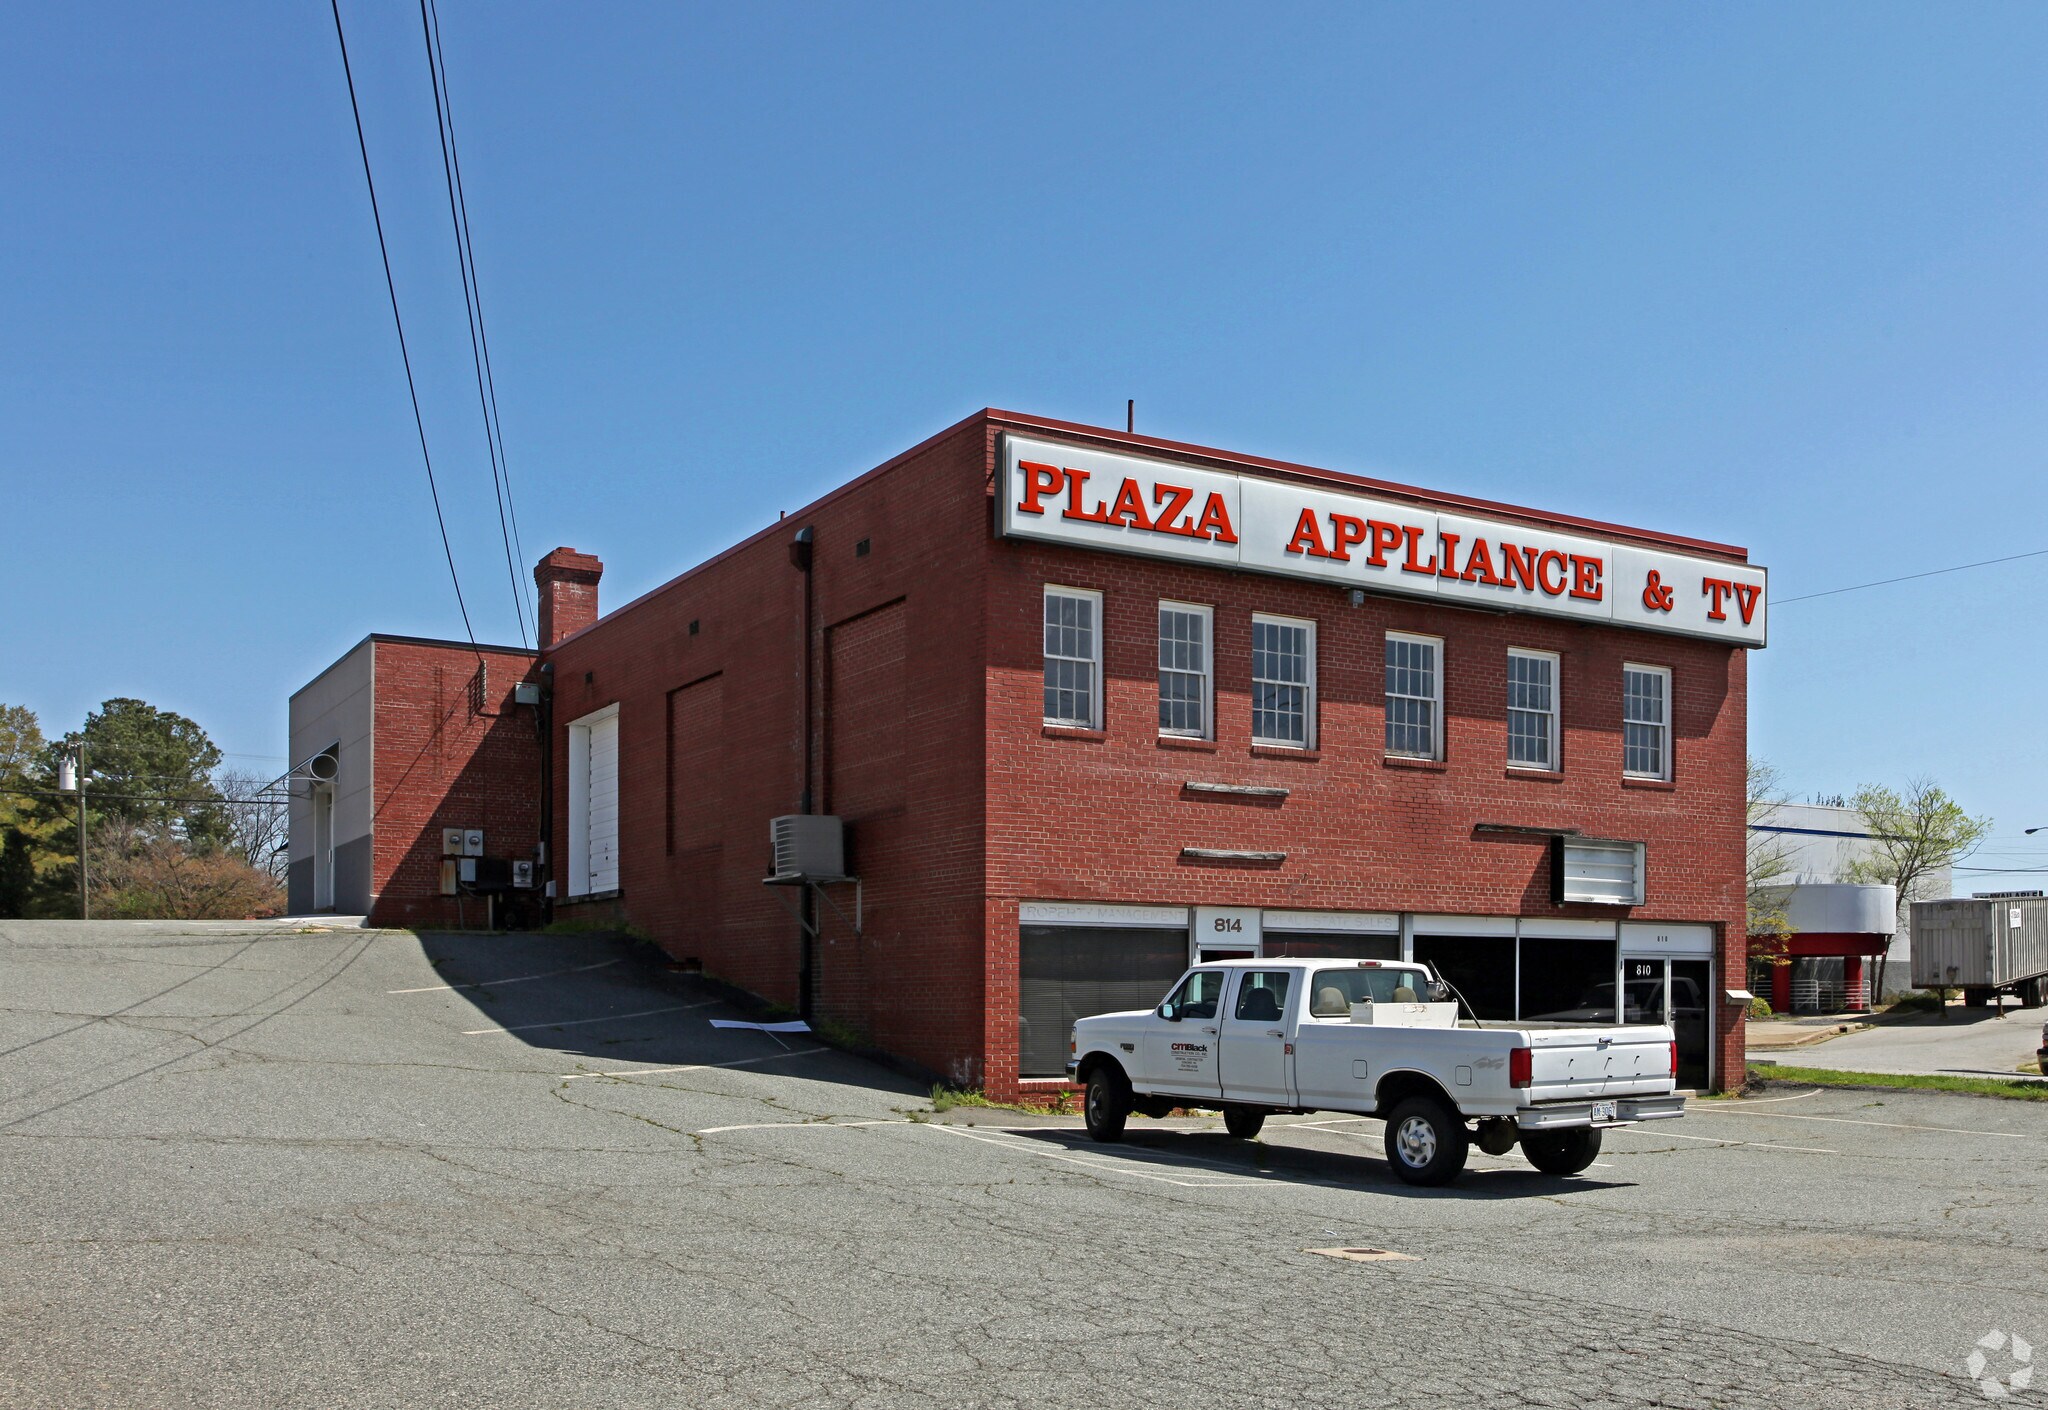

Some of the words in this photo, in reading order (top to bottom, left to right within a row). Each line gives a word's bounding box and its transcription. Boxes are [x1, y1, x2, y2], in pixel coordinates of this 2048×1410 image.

[1018, 459, 1239, 545] PLAZA
[1286, 508, 1603, 602] APPLIANCE
[1643, 568, 1674, 612] &
[1703, 576, 1762, 625] TV
[1214, 918, 1242, 932] 814
[1636, 965, 1652, 976] 810
